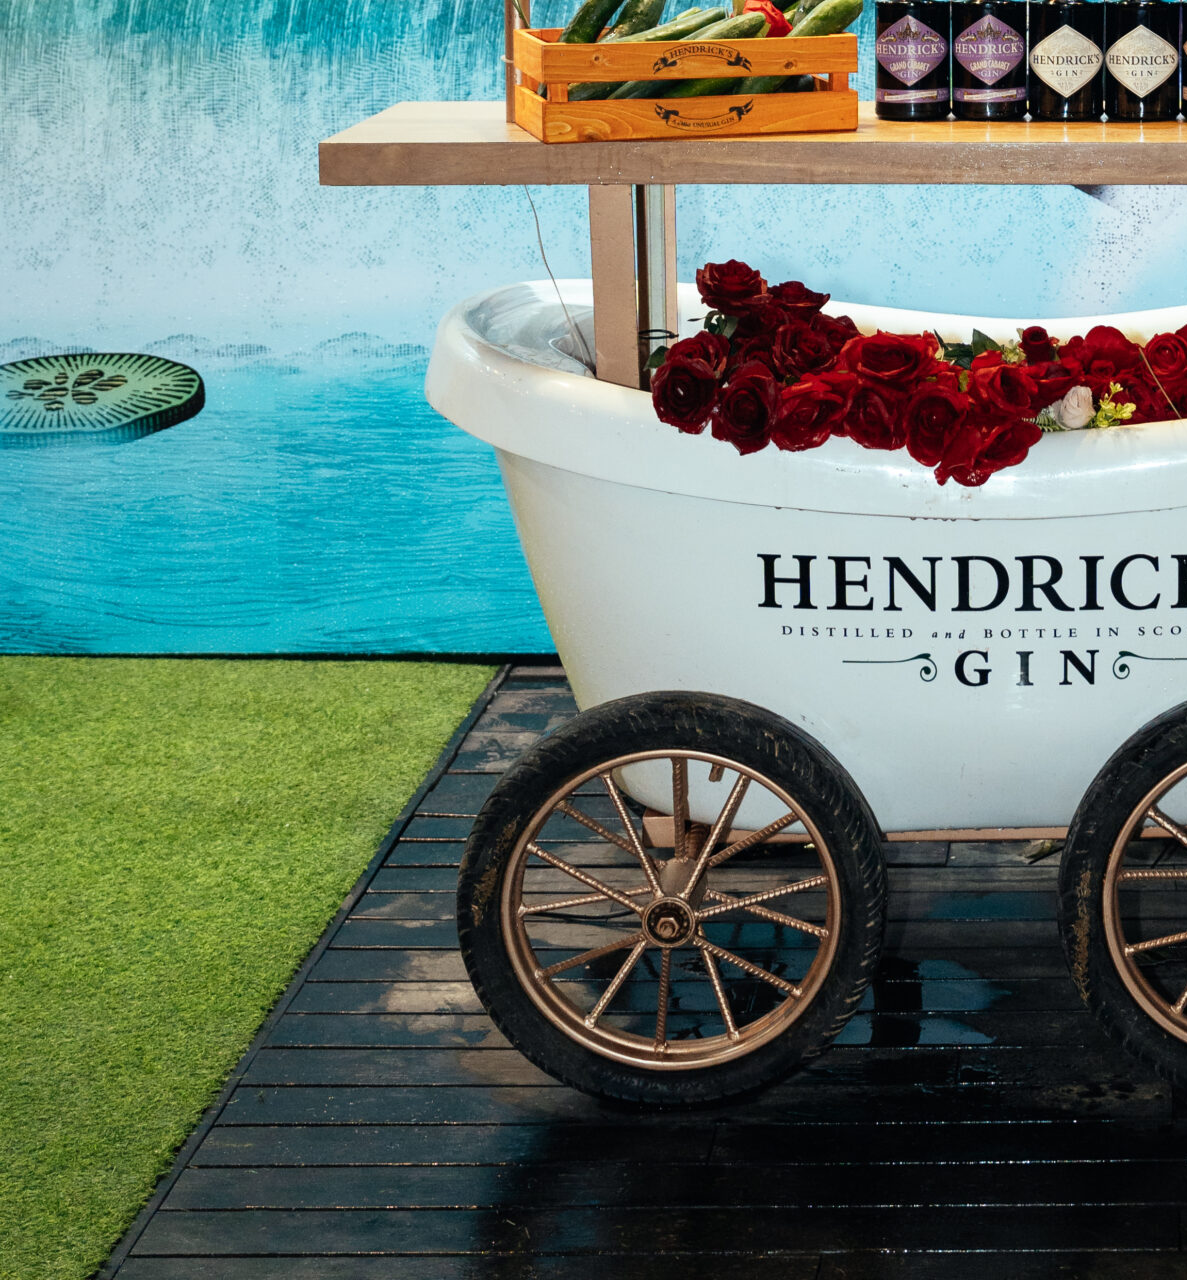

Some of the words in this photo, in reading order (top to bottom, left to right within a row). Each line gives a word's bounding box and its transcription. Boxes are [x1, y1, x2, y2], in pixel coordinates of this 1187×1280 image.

[669, 45, 733, 59] HENDRICK'S
[876, 43, 945, 55] HENDRICK'S
[955, 42, 1024, 55] HENDRICK'S
[1033, 54, 1100, 66] HENDRICK'S
[1109, 54, 1175, 66] HENDRICK'S
[900, 70, 918, 78] GIN
[781, 625, 914, 639] DISTILLED
[931, 628, 966, 640] and
[984, 627, 1078, 640] BOTTLE
[1096, 626, 1120, 638] IN
[954, 649, 1100, 687] GIN
